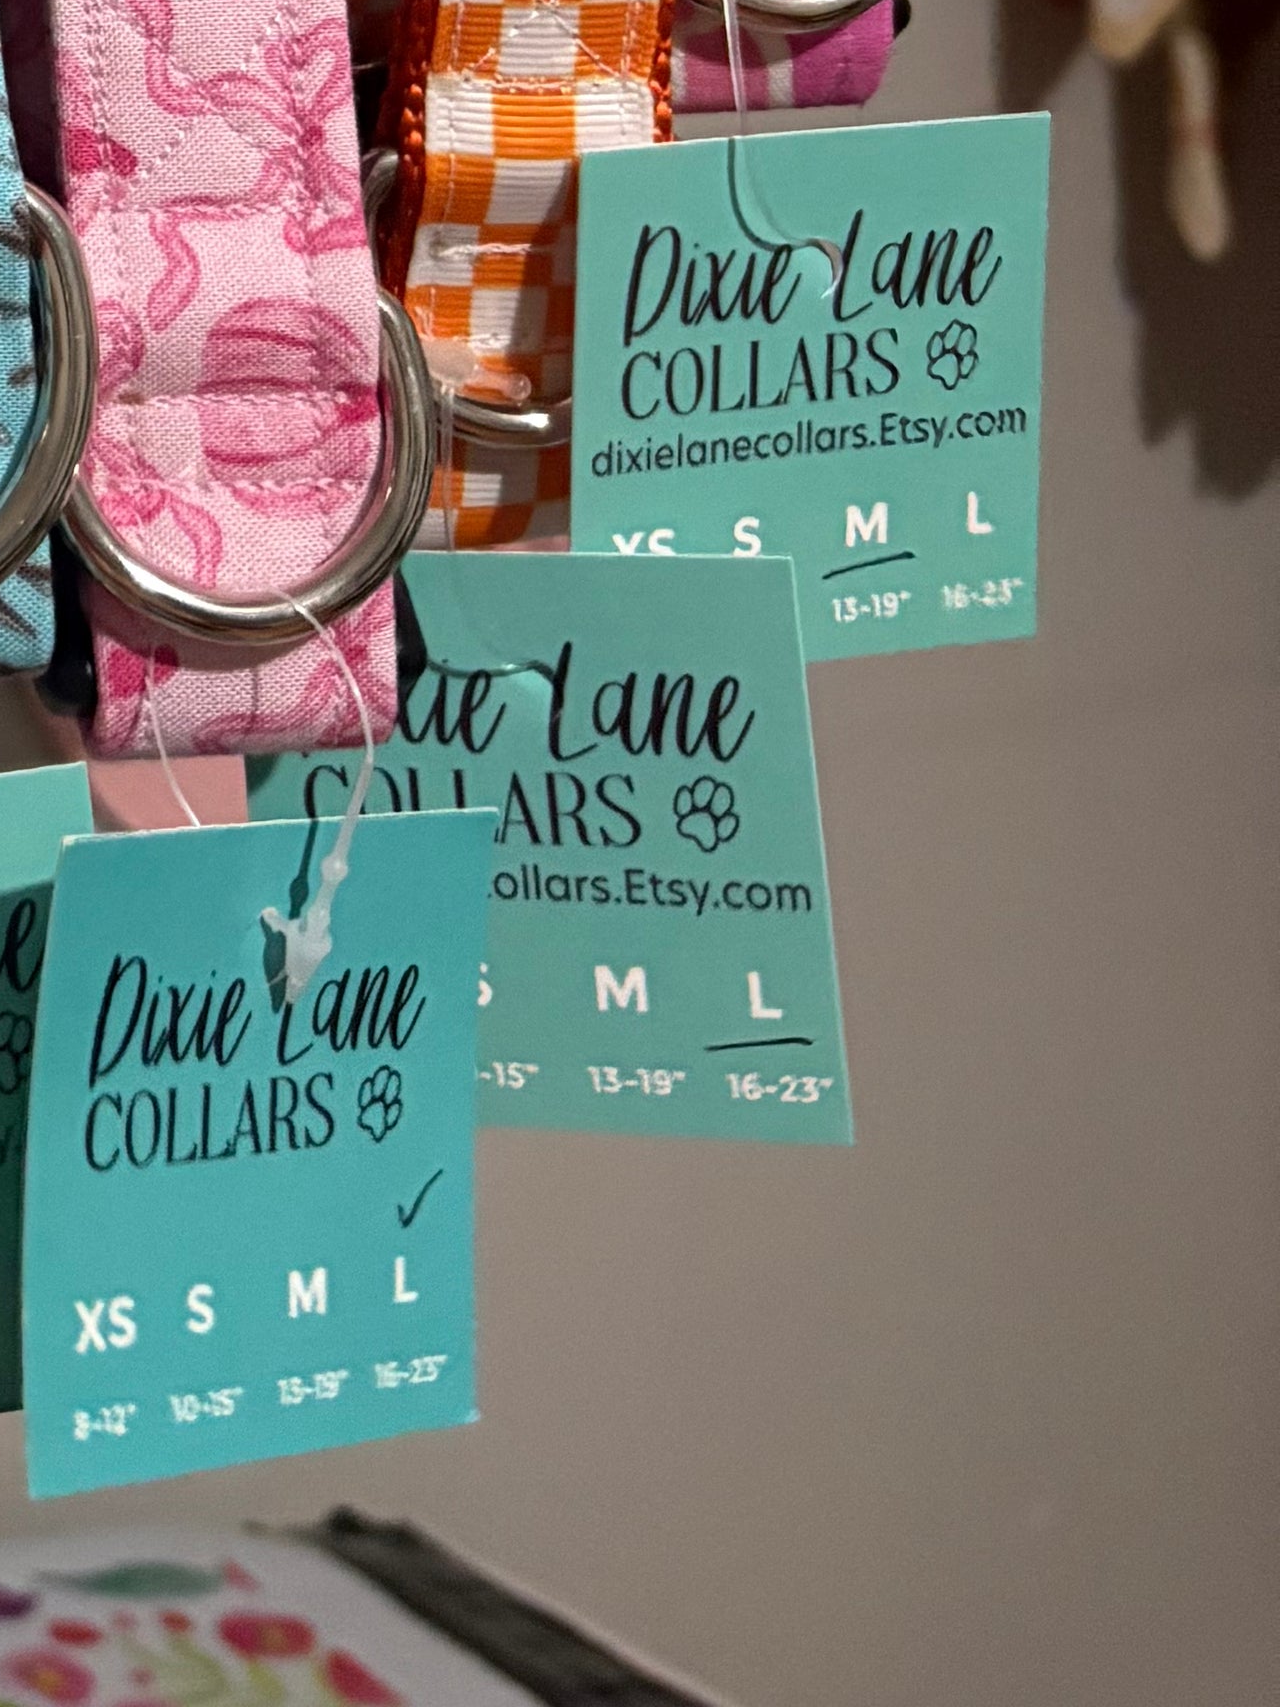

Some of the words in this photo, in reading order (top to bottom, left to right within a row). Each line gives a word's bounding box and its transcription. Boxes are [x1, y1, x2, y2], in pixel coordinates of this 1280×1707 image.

[622, 223, 802, 348] Dixie
[831, 208, 1002, 322] Lane
[621, 327, 900, 421] COLLARS
[591, 405, 1027, 478] dixielanecollars.Etsy.com
[733, 515, 762, 557] S
[845, 502, 888, 547] M
[967, 491, 995, 535] L
[550, 642, 755, 762] Lane
[495, 865, 812, 916] ollars.Etsy.com
[89, 953, 252, 1089] Dixie
[594, 965, 649, 1013] M
[746, 971, 783, 1019] L
[84, 1071, 335, 1173] COLLARS
[74, 1295, 137, 1354] XS
[186, 1283, 214, 1334] S
[288, 1267, 328, 1318] M
[394, 1256, 419, 1304] L
